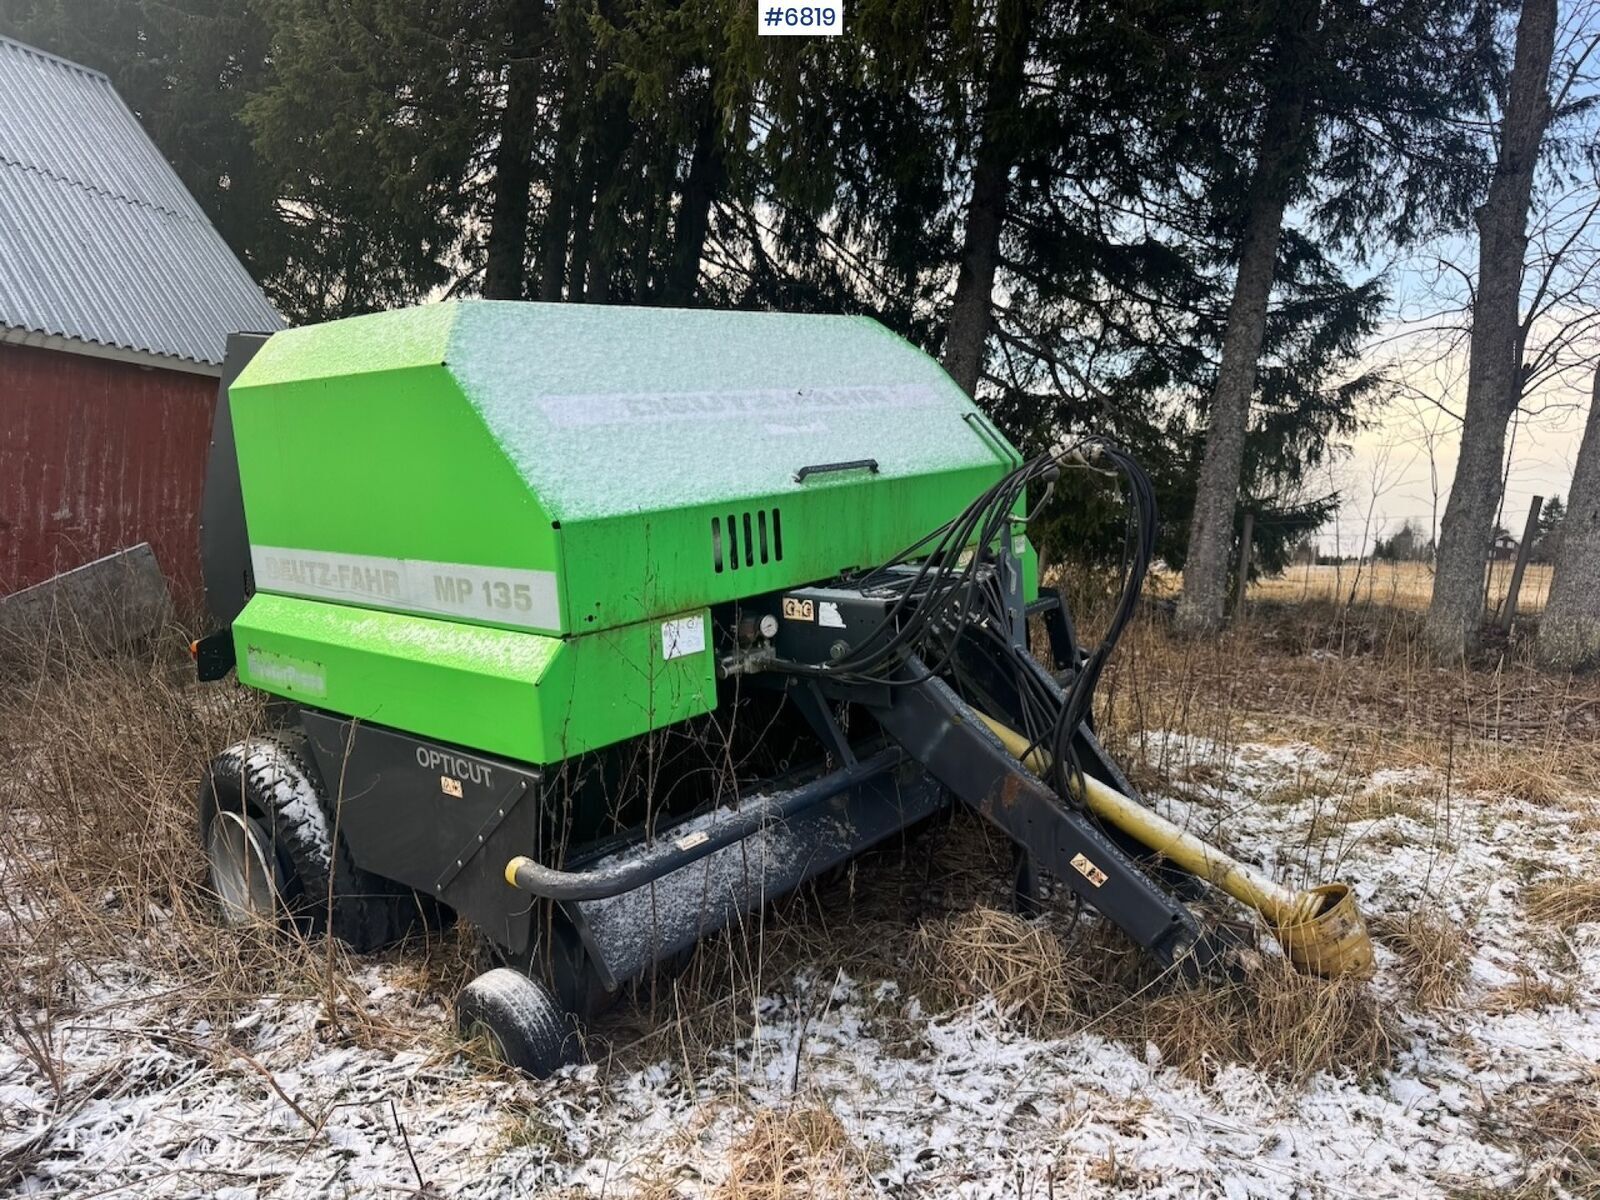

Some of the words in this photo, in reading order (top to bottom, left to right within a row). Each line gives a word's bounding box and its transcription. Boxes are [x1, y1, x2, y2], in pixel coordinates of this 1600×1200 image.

[264, 556, 401, 596] DEUTZ-FAHR
[433, 574, 474, 603] MP
[482, 580, 533, 613] 135
[416, 746, 492, 788] OPTICUT
